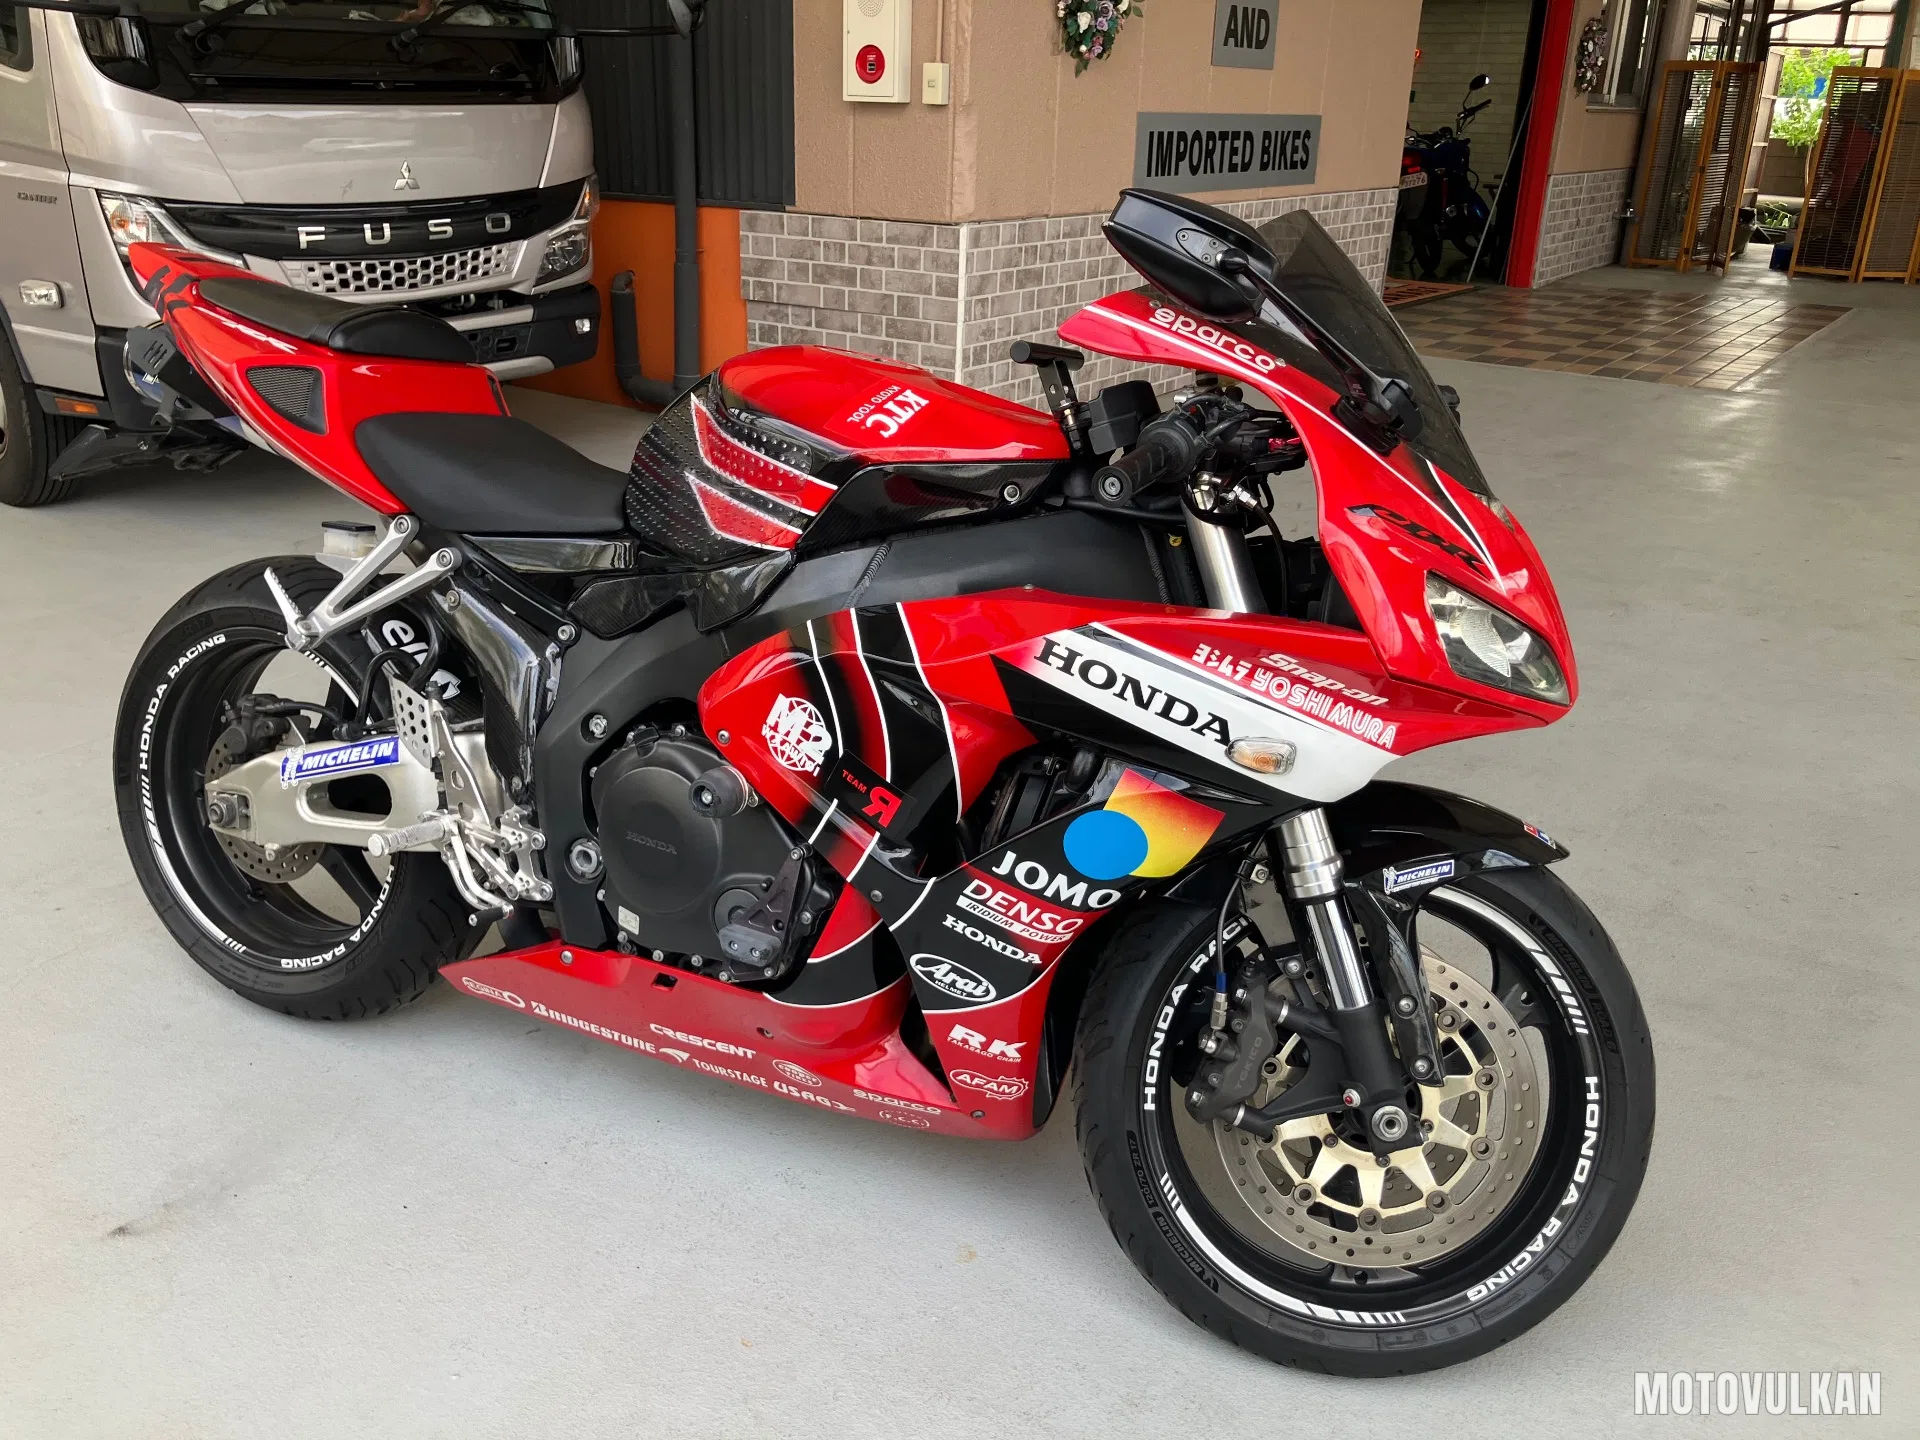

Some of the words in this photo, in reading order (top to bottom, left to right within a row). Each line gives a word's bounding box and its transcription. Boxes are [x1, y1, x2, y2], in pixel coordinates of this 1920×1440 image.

[1223, 5, 1270, 50] AND
[1146, 130, 1254, 177] IMPORTED
[1259, 130, 1311, 172] BIKES
[298, 213, 511, 249] FUSO
[1150, 307, 1276, 373] sparco
[847, 403, 875, 422] TOOL
[871, 385, 901, 404] KYOTO
[866, 389, 930, 438] KTC
[1192, 642, 1252, 682] ヨシムラ
[1260, 653, 1389, 706] Snap-on
[140, 683, 167, 771] HONDA
[167, 633, 226, 679] RACING
[1033, 637, 1232, 746] HONDA
[1254, 668, 1396, 749] YOSHIMURA
[302, 742, 394, 771] MICHELIN
[842, 769, 868, 794] TEAM
[626, 830, 678, 855] HONDA
[992, 850, 1121, 909] JOMO
[1396, 864, 1451, 884] MICHELIN
[349, 864, 395, 943] HONDA
[963, 879, 1084, 934] DENSO
[942, 913, 1042, 964] HONDA
[966, 902, 1014, 928] IRIDIUM
[1021, 926, 1068, 943] POWER
[280, 942, 347, 970] RACING
[914, 963, 989, 996] Arai
[935, 980, 968, 997] HELMET
[531, 1000, 656, 1054] BRIDGESTONE
[1144, 984, 1188, 1111] HONDA
[1190, 917, 1249, 974] RACI
[649, 1022, 756, 1059] CRESCENT
[947, 1036, 994, 1058] TAKASAGO
[949, 1023, 1027, 1058] RK
[692, 1058, 768, 1088] TOURSTAGE
[956, 1073, 1018, 1093] AFAM
[773, 1081, 832, 1108] USAG
[853, 1089, 941, 1115] sparco
[1129, 1138, 1137, 1150] 17
[1132, 1152, 1142, 1167] ZR
[1562, 1076, 1600, 1207] HONDA
[1137, 1169, 1155, 1205] 120/70
[1155, 1216, 1203, 1274] MICHELIN
[1467, 1216, 1562, 1302] RACING
